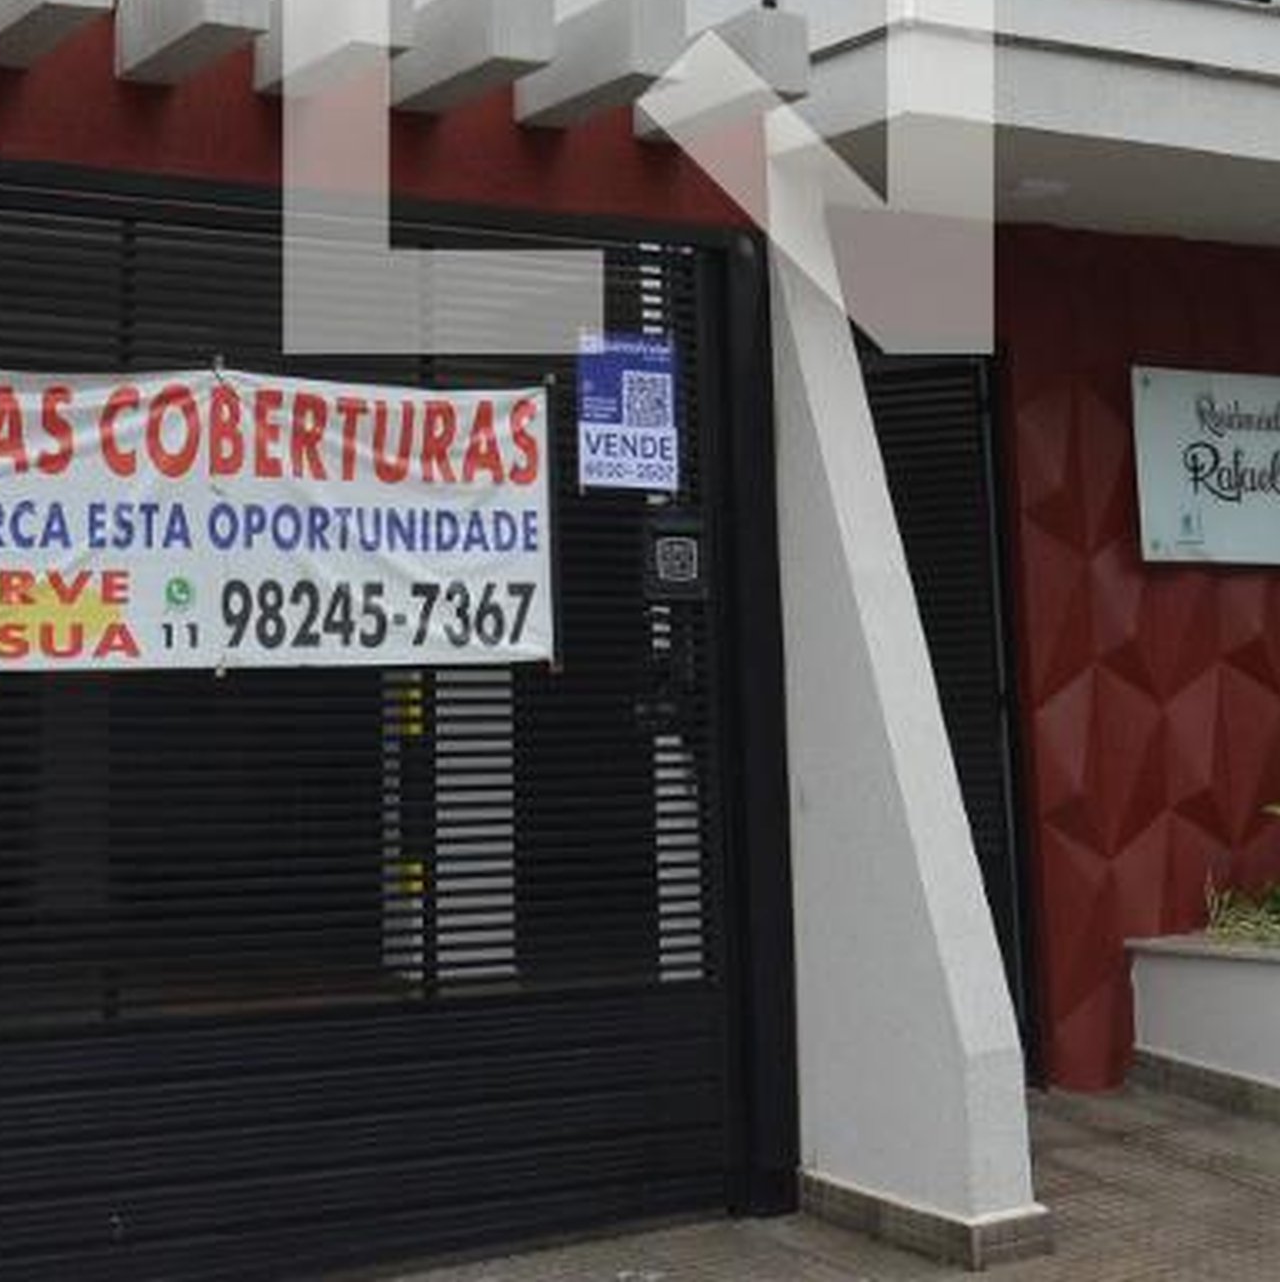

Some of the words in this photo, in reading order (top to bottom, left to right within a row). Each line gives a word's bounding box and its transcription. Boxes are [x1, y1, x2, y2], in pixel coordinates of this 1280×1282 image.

[98, 382, 540, 486] COBERTURAS
[584, 429, 674, 461] VENDE
[87, 502, 192, 550] ESTA
[208, 502, 539, 553] OPORTUNIDADE
[161, 621, 200, 649] 11
[220, 578, 537, 650] 98245-7367
